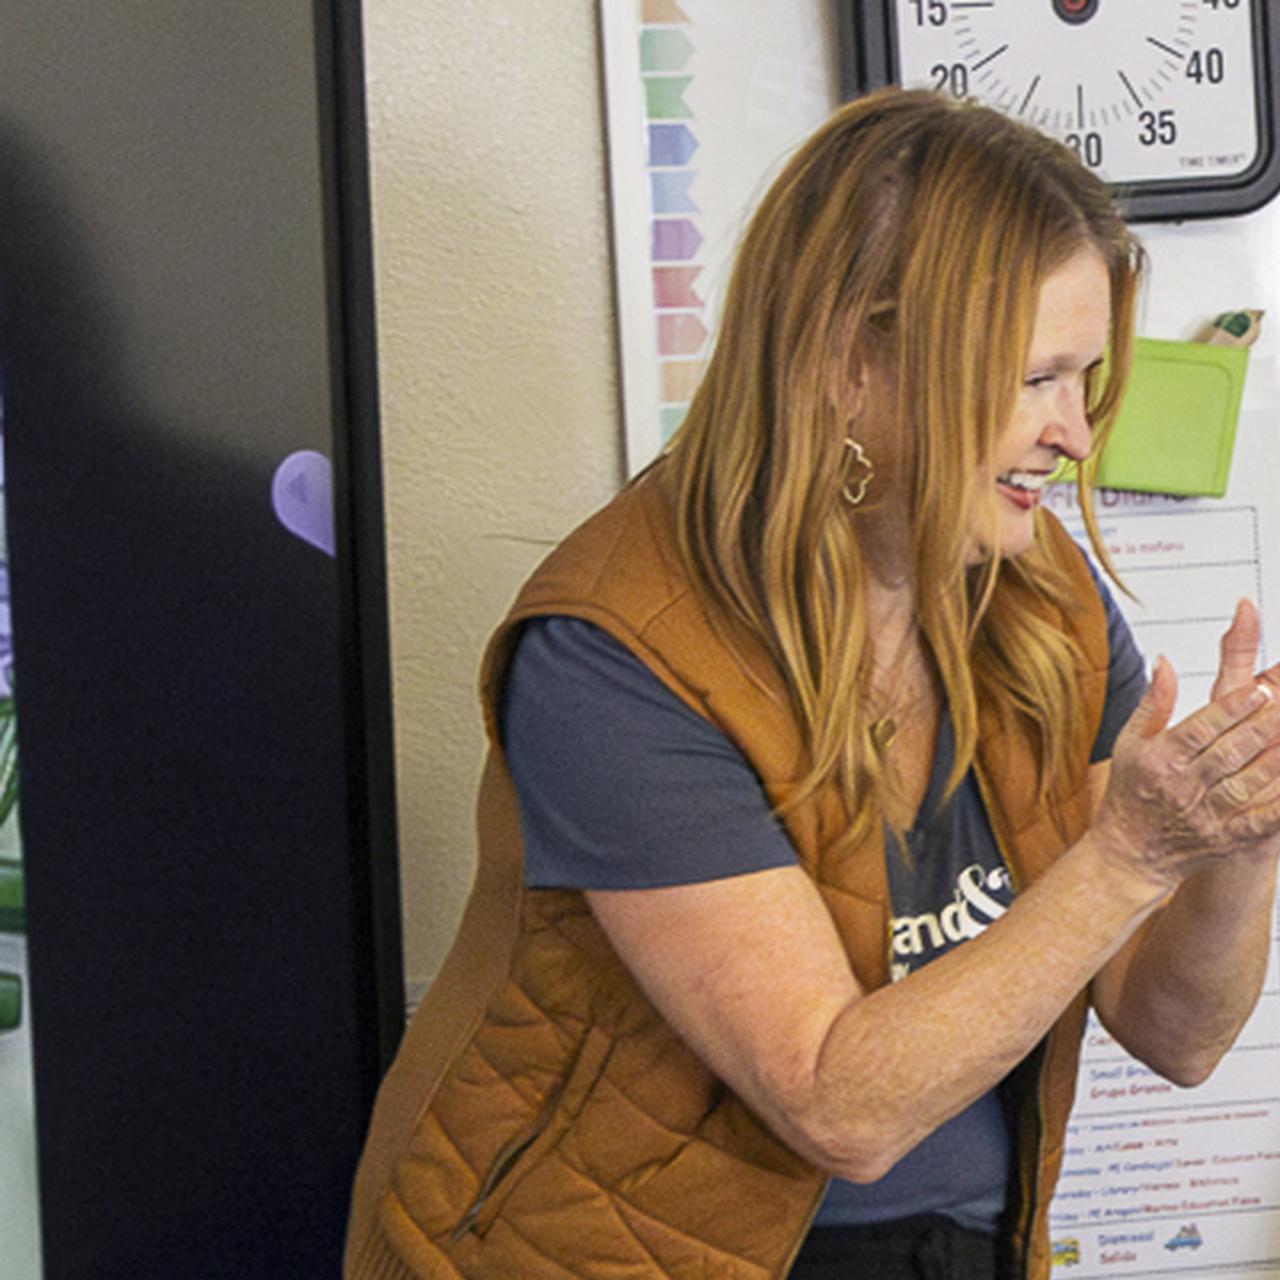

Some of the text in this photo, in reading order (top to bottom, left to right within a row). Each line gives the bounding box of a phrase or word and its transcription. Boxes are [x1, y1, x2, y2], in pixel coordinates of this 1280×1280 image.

[912, 0, 947, 26] 15
[930, 63, 968, 98] 20
[1185, 48, 1224, 84] 40
[1138, 110, 1176, 145] 35
[1089, 1064, 1153, 1081] Small Gro
[1098, 1231, 1155, 1246] Dismissal
